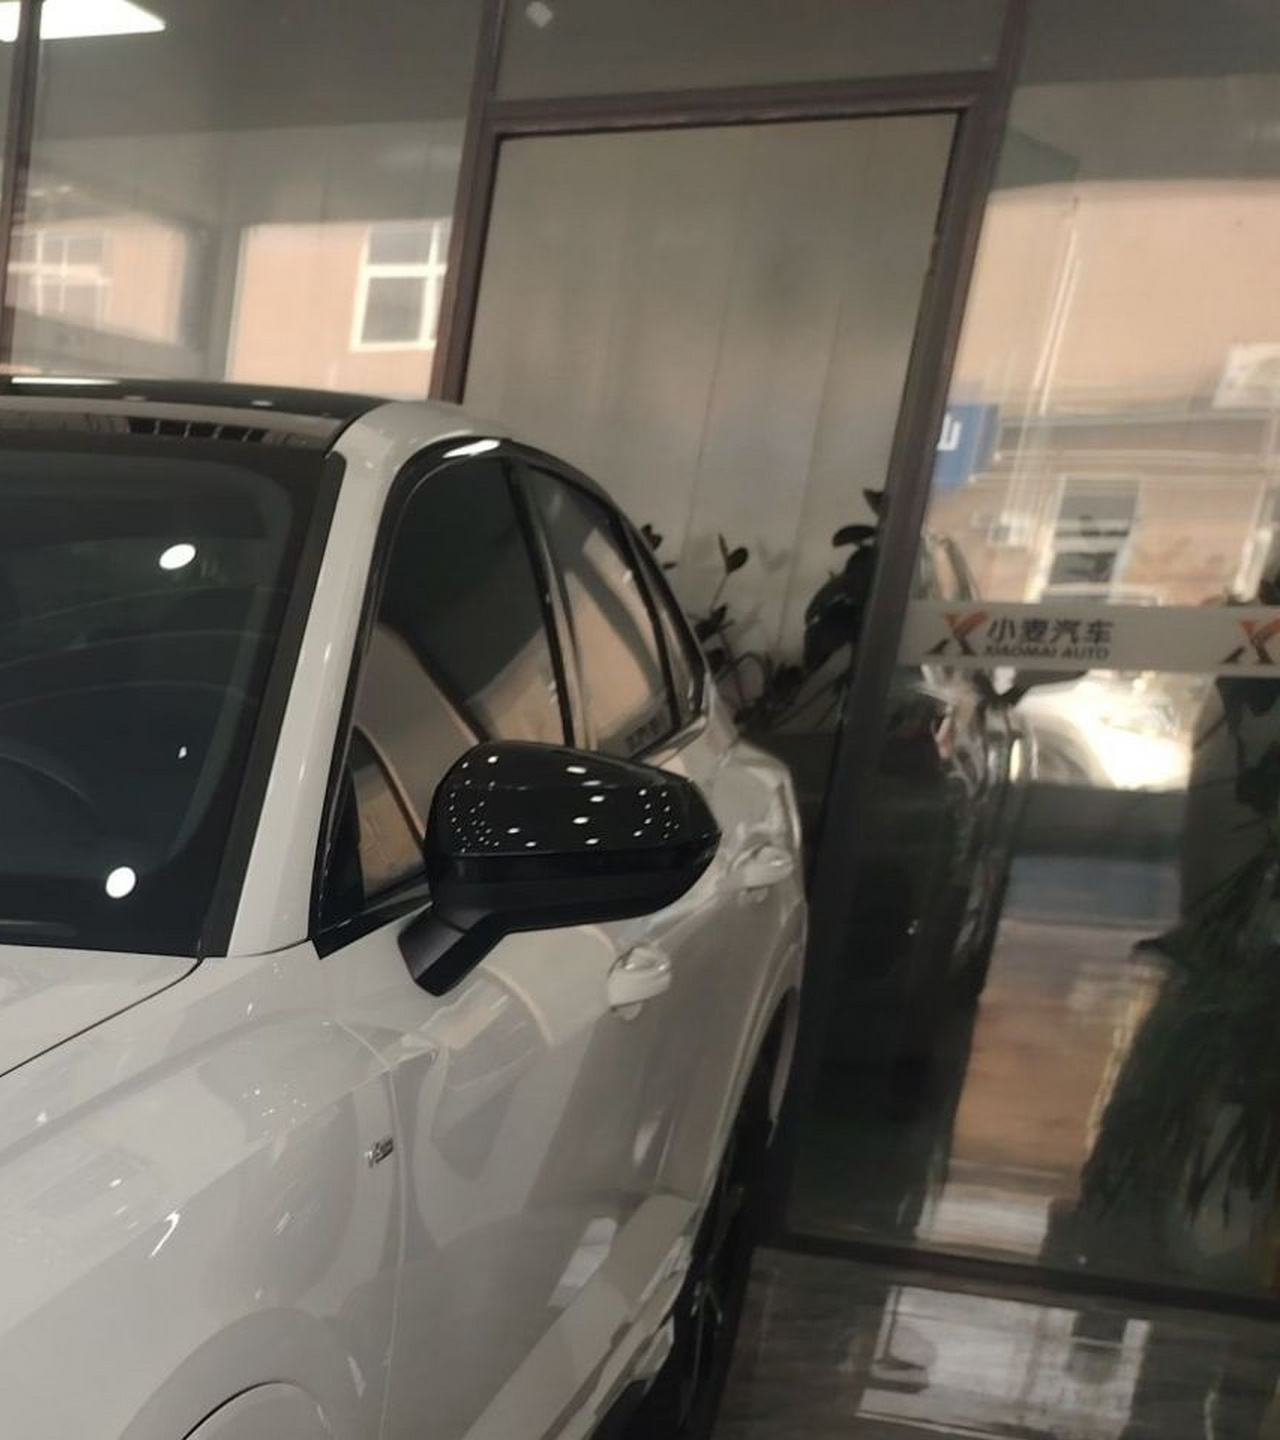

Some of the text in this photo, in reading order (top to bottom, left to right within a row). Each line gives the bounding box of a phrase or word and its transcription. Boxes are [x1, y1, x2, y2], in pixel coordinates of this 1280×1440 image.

[987, 616, 1114, 645] 小麦汽车
[1060, 646, 1110, 660] AUTO
